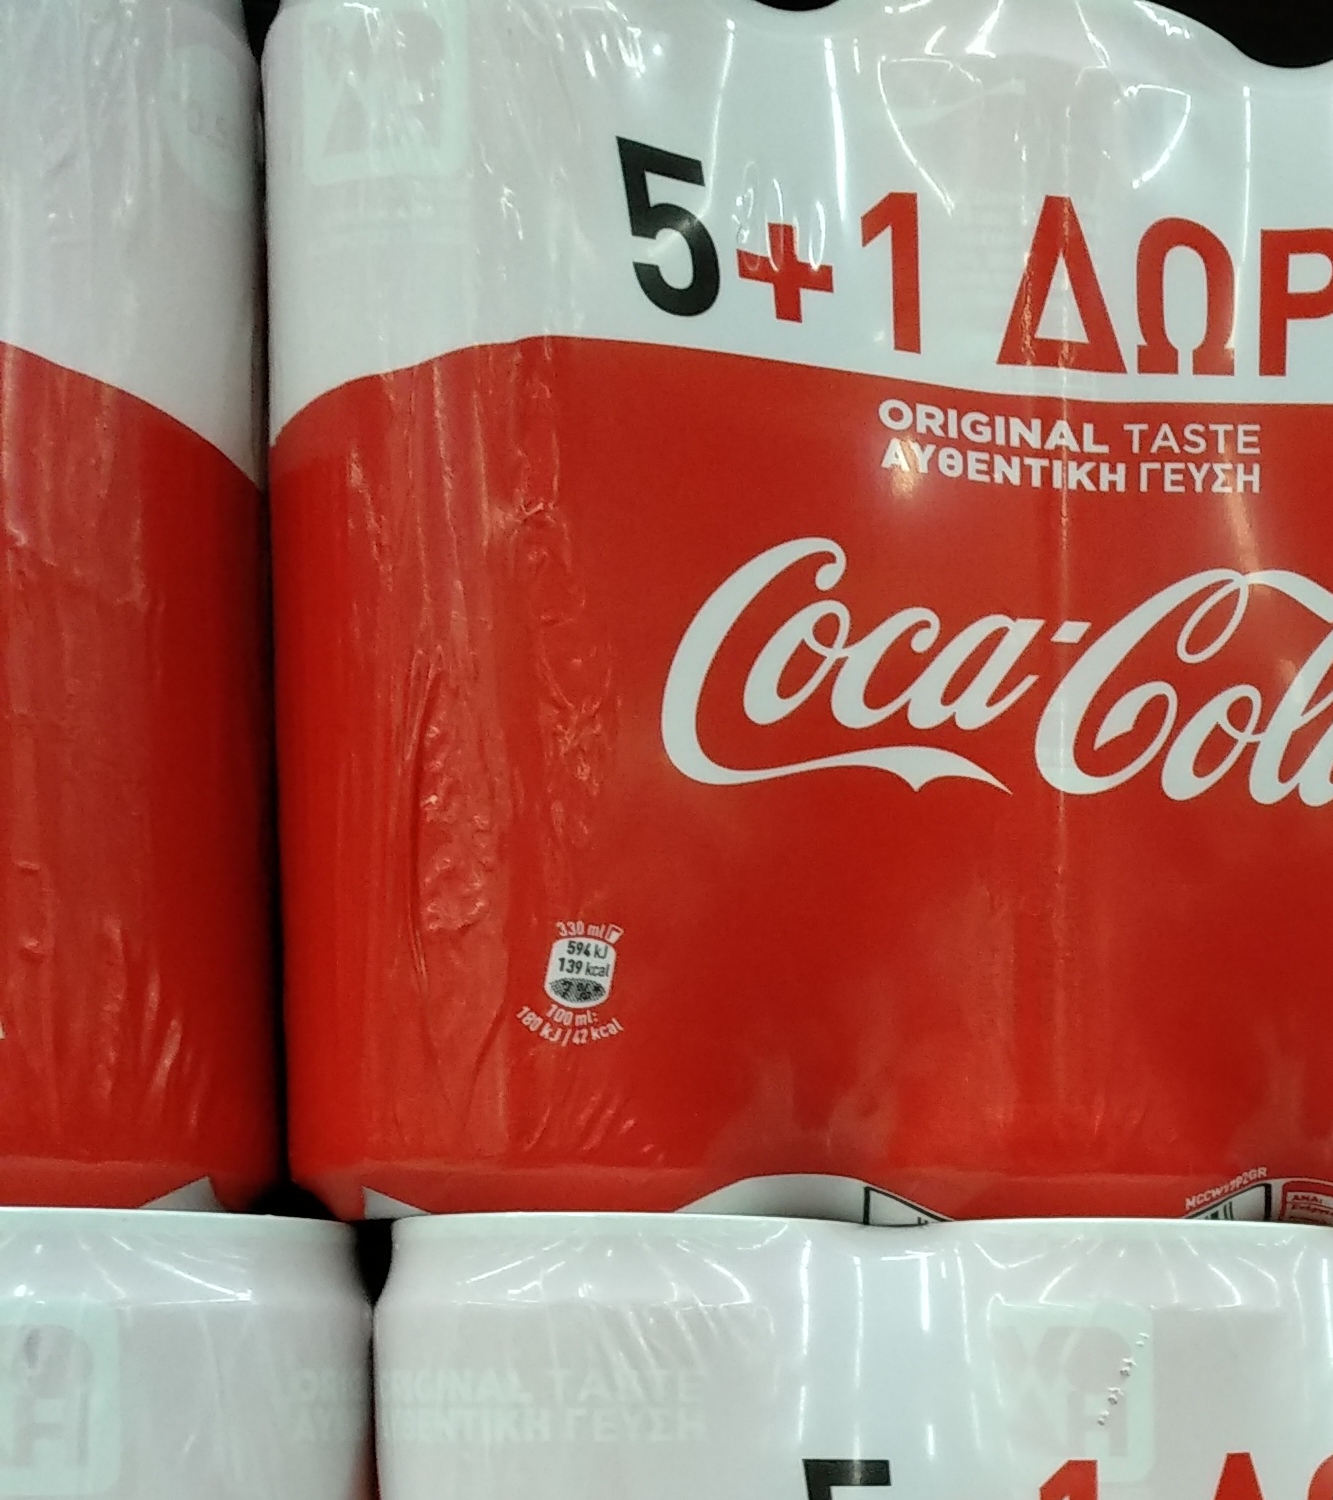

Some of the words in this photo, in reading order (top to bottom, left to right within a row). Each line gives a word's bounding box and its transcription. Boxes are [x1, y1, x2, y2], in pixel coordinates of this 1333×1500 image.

[616, 136, 922, 354] 5+1
[878, 399, 1109, 455] ORIGINAL
[1123, 424, 1261, 455] TASTE
[881, 448, 1127, 492] ΑΥΘΕΝΤΙΚΗ
[1138, 462, 1260, 494] ΓΕΥΣΗ
[558, 957, 583, 975] 139
[567, 940, 591, 957] 594
